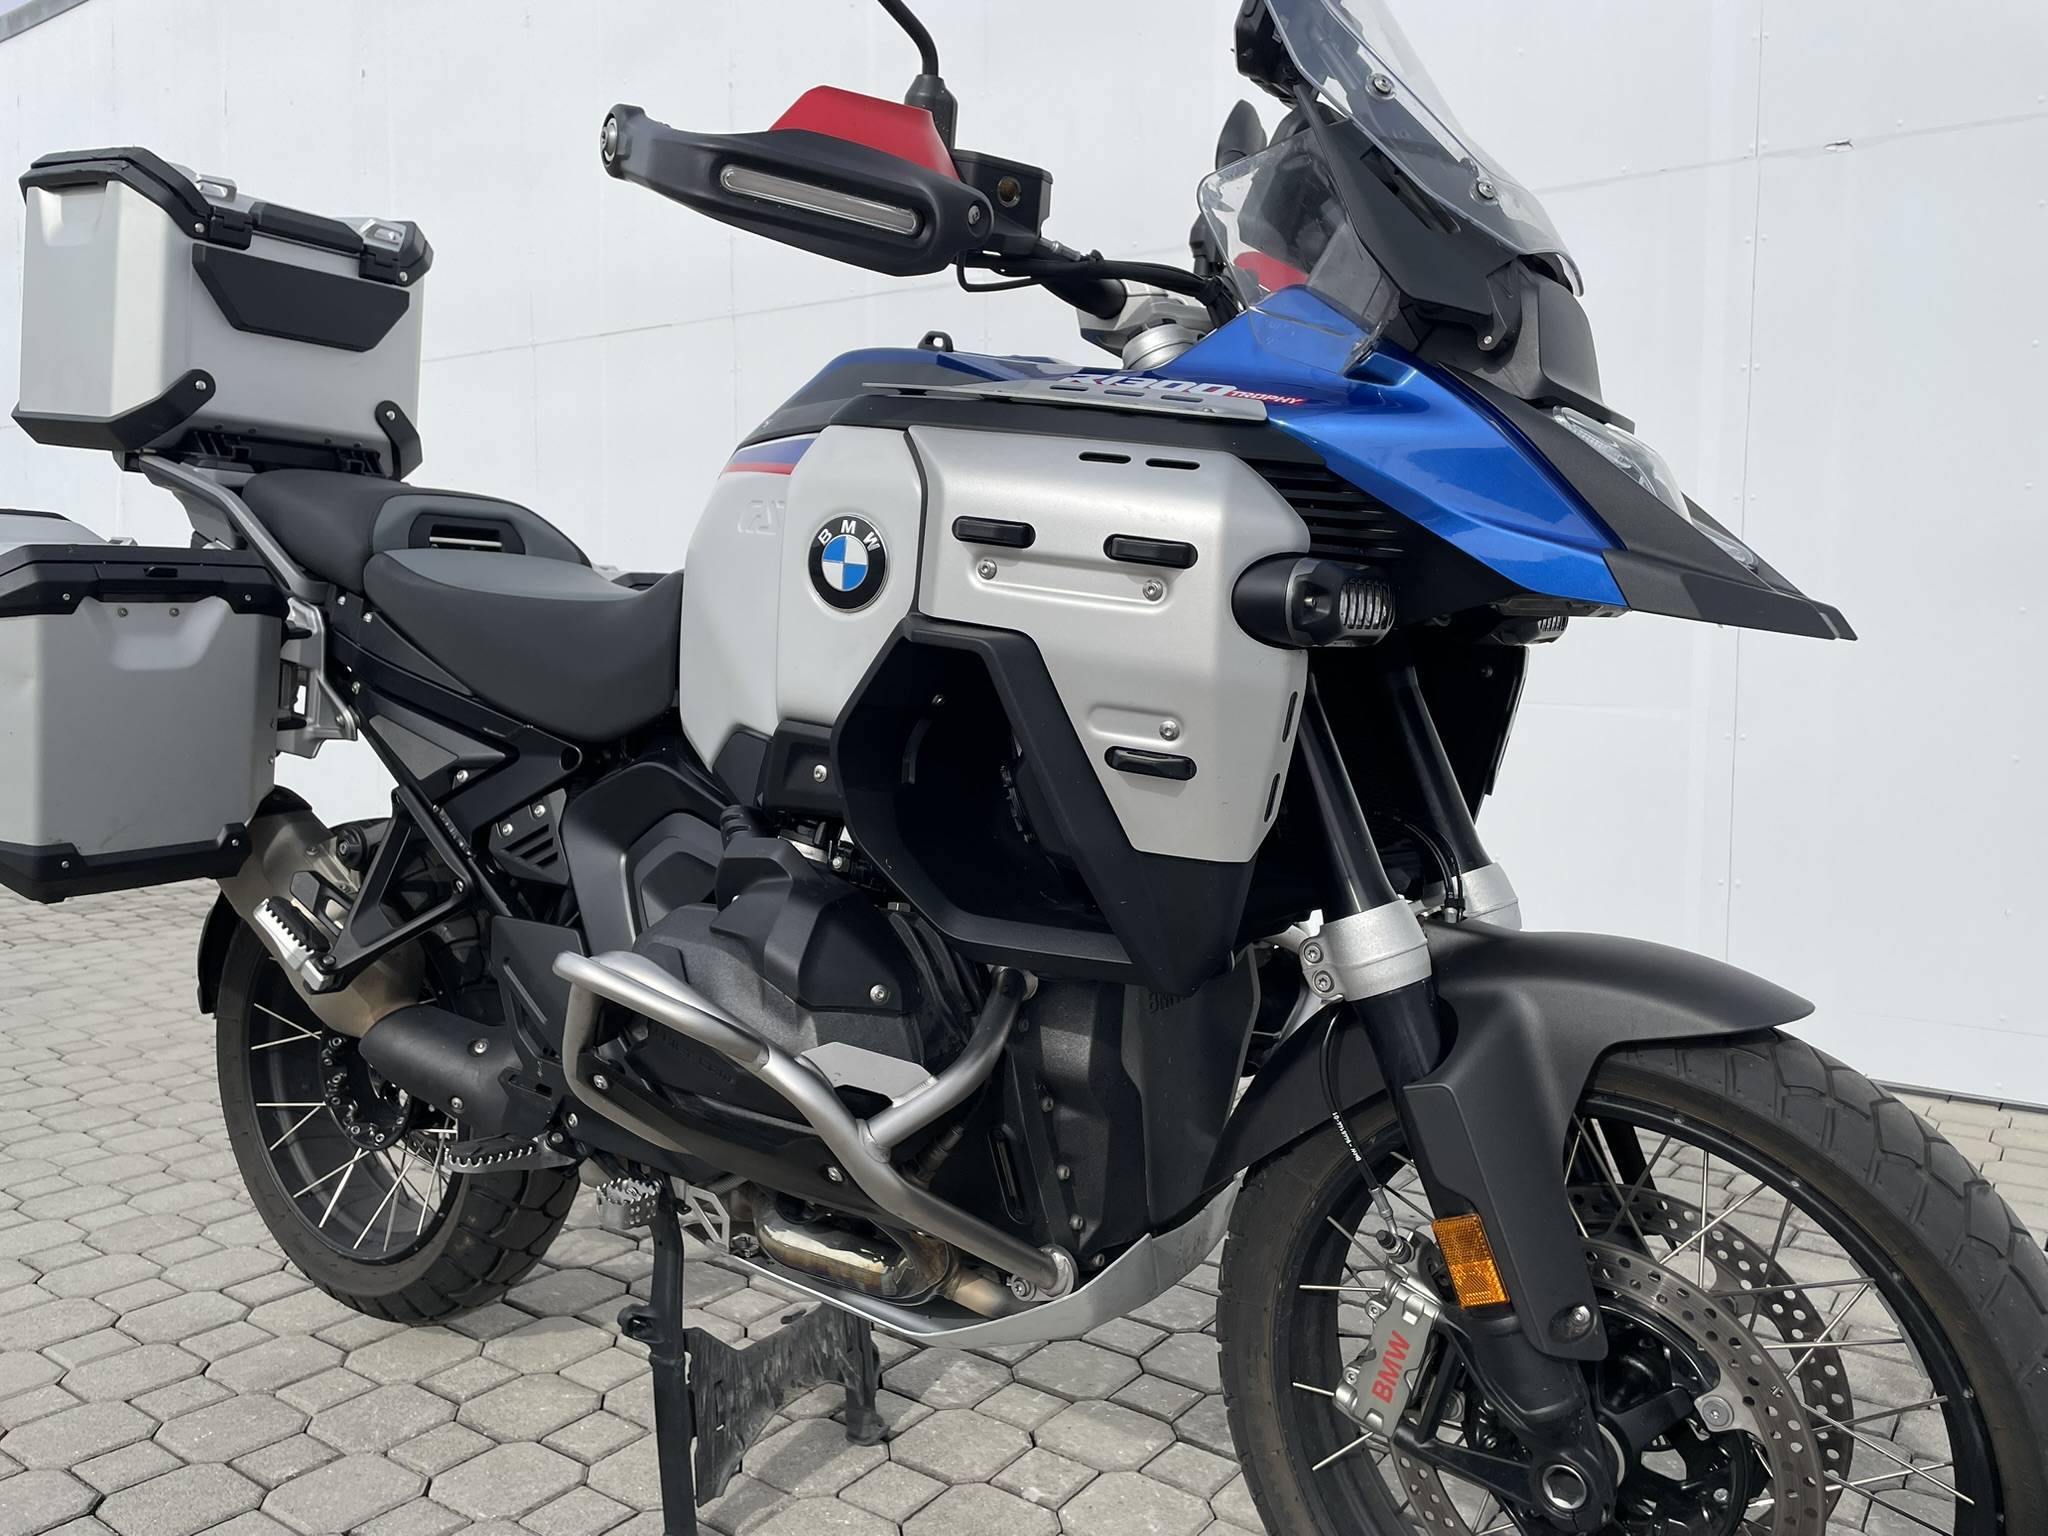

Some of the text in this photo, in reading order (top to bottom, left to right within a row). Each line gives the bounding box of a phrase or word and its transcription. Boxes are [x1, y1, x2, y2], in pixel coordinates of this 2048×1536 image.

[1228, 390, 1304, 405] TROPHY
[817, 519, 881, 552] BMW
[1371, 1329, 1411, 1404] BMW
